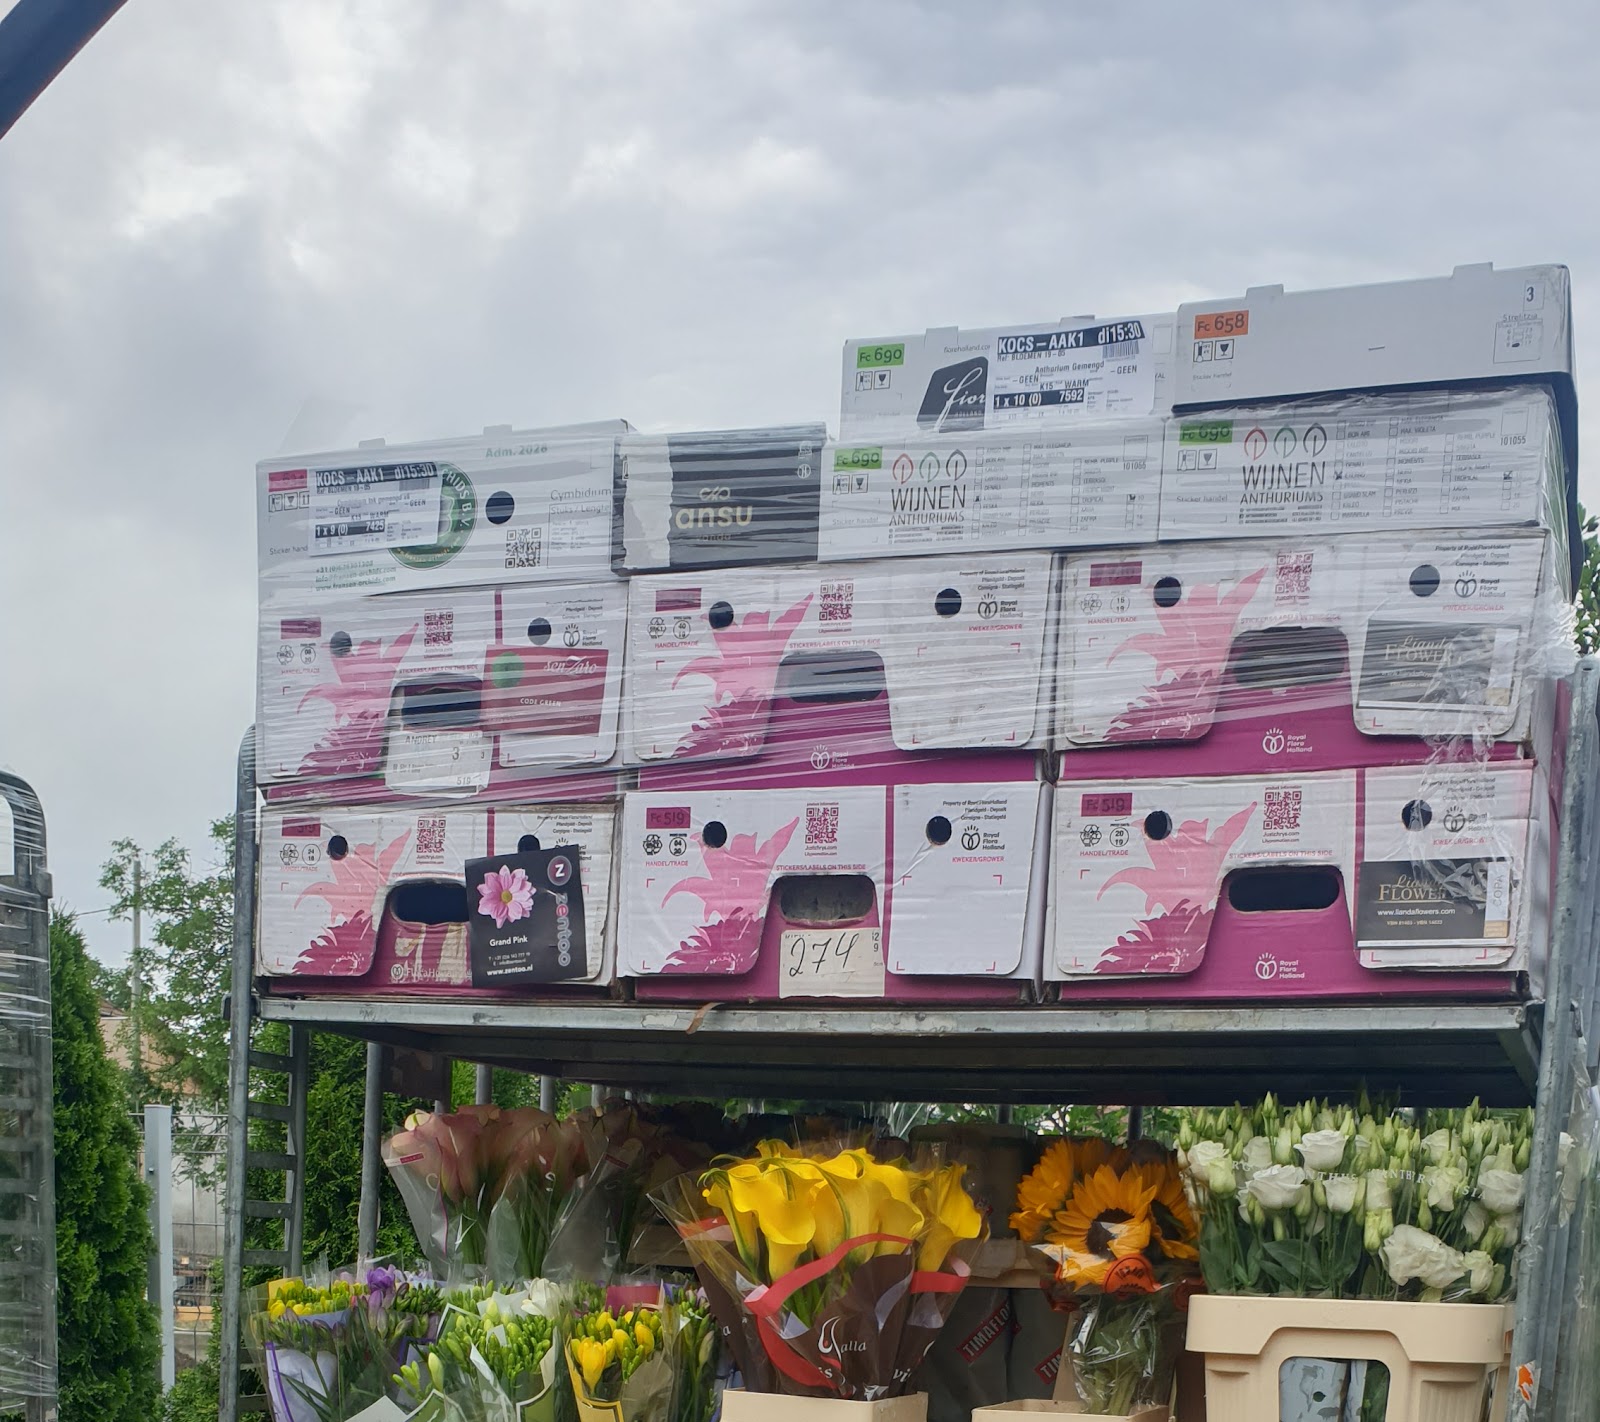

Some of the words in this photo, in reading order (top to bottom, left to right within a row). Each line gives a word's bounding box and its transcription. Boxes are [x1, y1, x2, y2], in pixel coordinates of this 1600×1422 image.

[1526, 287, 1534, 302] 3
[1198, 321, 1210, 331] Fc
[1214, 313, 1244, 333] 658
[1098, 322, 1141, 344] di15:30
[860, 354, 871, 362] Fc
[874, 347, 902, 363] 690
[1035, 365, 1069, 373] Anthurium
[1072, 362, 1104, 371] Gemengd
[1065, 380, 1089, 388] WARM
[1014, 394, 1025, 405] 10
[1028, 393, 1042, 406] (0)
[1060, 390, 1083, 402] 7592
[1242, 461, 1326, 490] WIJNEN
[891, 485, 966, 512] WIJNEN
[1240, 491, 1323, 505] ANTHURIUMS
[676, 506, 752, 529] ansu
[889, 511, 964, 526] ANTHURIUMS
[331, 526, 336, 535] 9
[366, 521, 384, 531] 7425
[453, 747, 459, 760] 3
[457, 777, 471, 785] 519
[664, 812, 685, 825] 519
[555, 893, 572, 966] zentoo
[489, 938, 511, 947] Grand
[513, 936, 528, 944] Pink
[789, 932, 859, 977] 274
[487, 965, 533, 976] www.zentoo.nl
[1279, 959, 1299, 967] Royal
